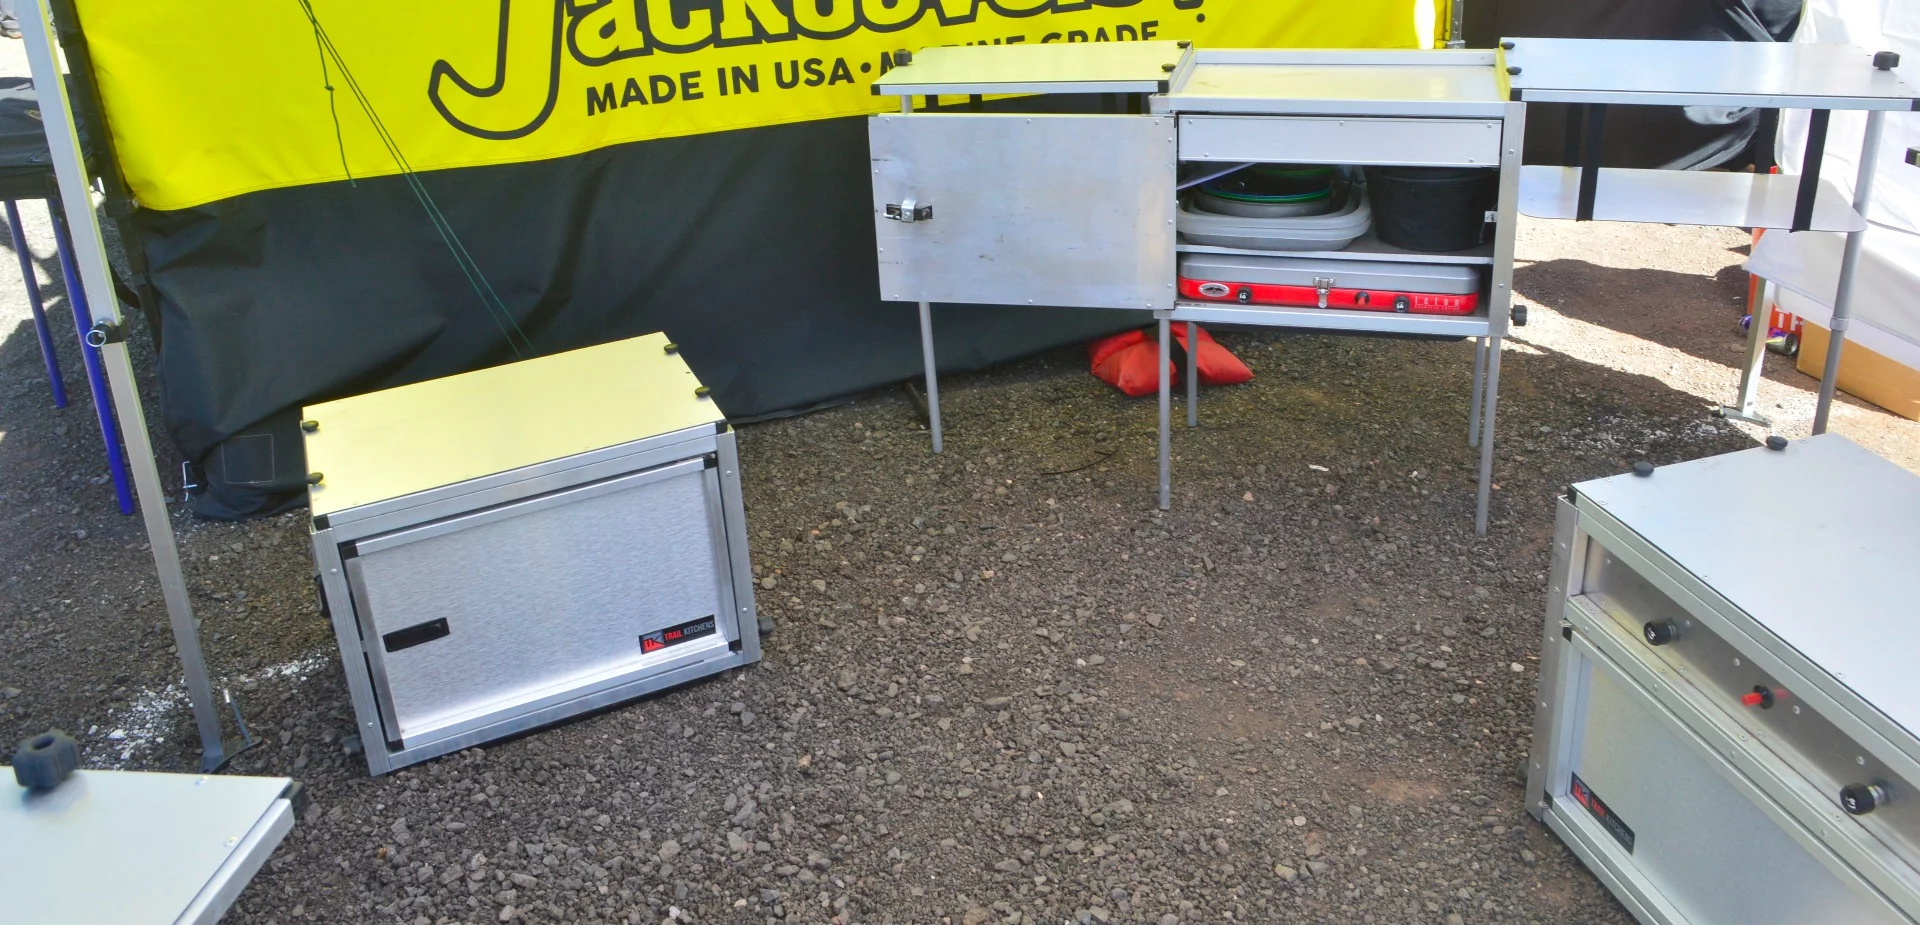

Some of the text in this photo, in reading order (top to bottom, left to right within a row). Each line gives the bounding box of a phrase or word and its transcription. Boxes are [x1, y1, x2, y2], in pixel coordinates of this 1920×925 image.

[586, 71, 704, 116] MADE
[717, 64, 760, 97] IN
[774, 57, 855, 89] USA
[664, 620, 715, 641] TRAIL KITCHENS
